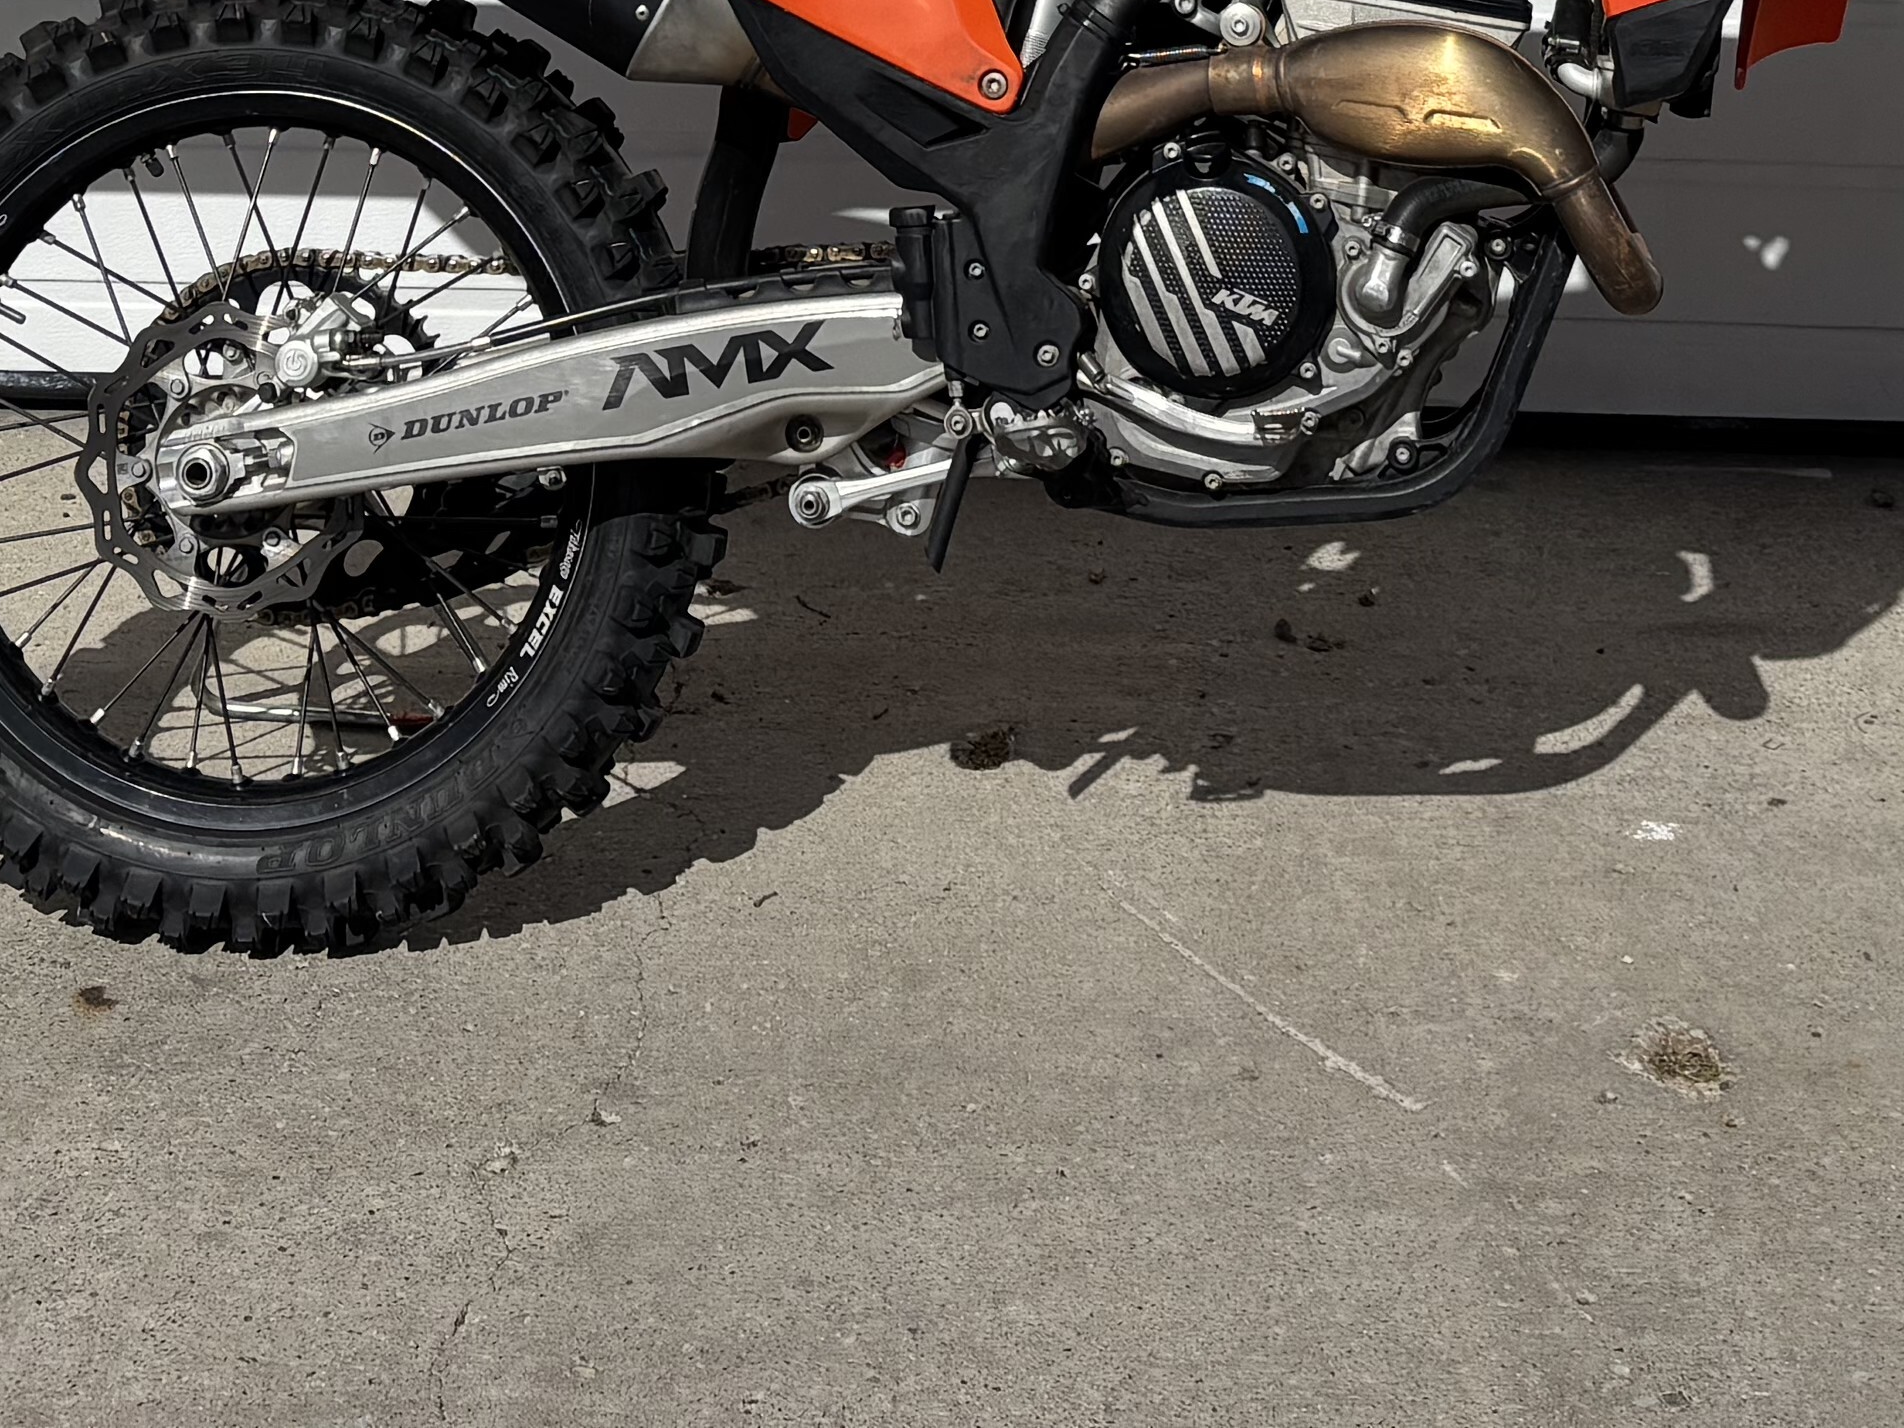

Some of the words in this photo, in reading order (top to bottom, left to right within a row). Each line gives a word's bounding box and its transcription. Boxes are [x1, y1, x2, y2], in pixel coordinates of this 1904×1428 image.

[1211, 288, 1279, 326] KTM
[400, 390, 563, 440] DUNLOP
[520, 584, 564, 657] EXCEL
